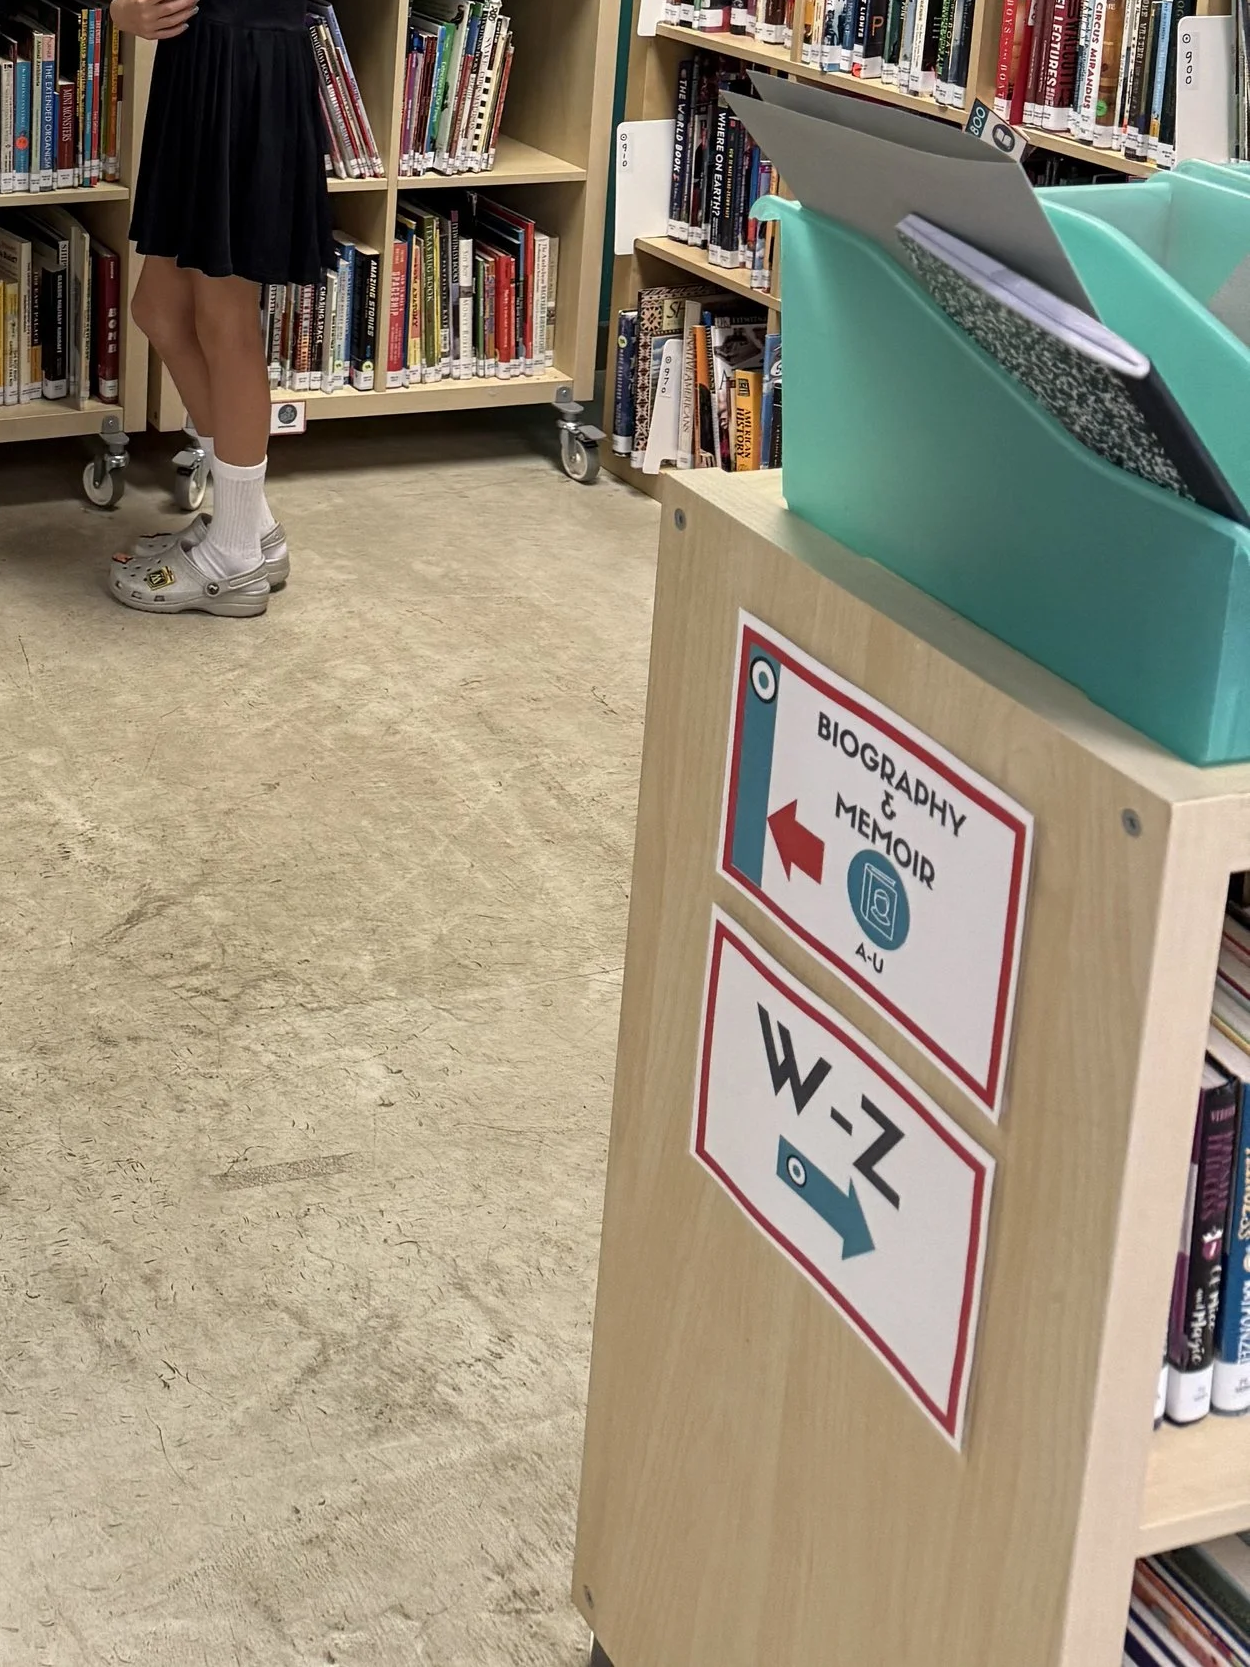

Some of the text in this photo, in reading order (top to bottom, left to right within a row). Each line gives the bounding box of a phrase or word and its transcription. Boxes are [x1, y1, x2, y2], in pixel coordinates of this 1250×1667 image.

[858, 7, 867, 38] LIGHTS
[998, 0, 1015, 99] BOYS BOAT
[1046, 15, 1063, 88] LECTURES
[1092, 2, 1104, 44] CIRCUS
[1083, 47, 1099, 110] MIRANDUS
[1185, 51, 1193, 85] 900
[43, 85, 53, 169] EXTENDED ORGANISM
[61, 106, 72, 142] MONSTERS
[674, 103, 686, 177] WORLD BOOK
[970, 105, 986, 137] 800
[712, 112, 727, 216] WHERE ON EARTH?
[426, 223, 434, 302] TEXAS BOOK
[316, 285, 326, 344] CHASING SPACE
[367, 259, 378, 337] AMAZING STORIES
[660, 368, 670, 394] 970
[682, 336, 696, 434] NATIVE AMERICANS
[736, 407, 745, 459] HISTORY
[744, 408, 752, 459] AMERICAN
[816, 710, 969, 838] BIOGRAPHY
[881, 789, 897, 821] &
[833, 792, 938, 891] MEMOIR
[855, 942, 885, 974] A-U
[756, 1001, 904, 1210] W-Z
[1190, 1310, 1209, 1365] Magic
